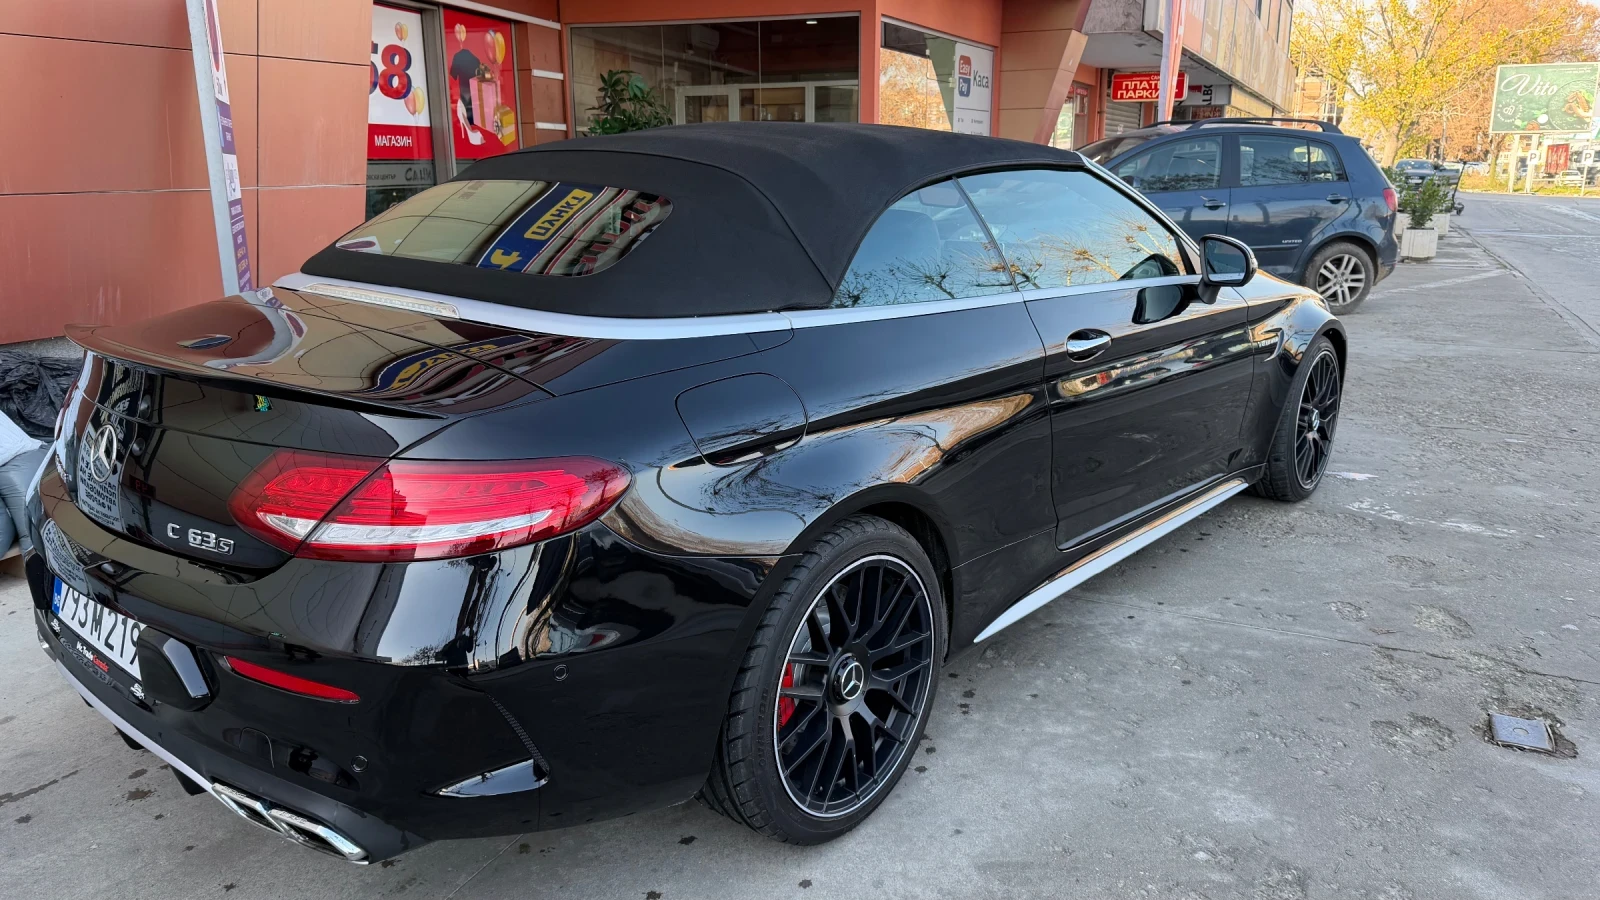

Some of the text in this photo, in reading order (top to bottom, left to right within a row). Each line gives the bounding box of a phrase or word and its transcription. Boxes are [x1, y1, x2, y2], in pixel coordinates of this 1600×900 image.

[959, 60, 971, 76] Easy
[959, 78, 968, 94] Pay
[1501, 73, 1558, 96] Vito
[374, 135, 412, 147] МАГАЗИН
[1530, 153, 1537, 161] P
[1584, 153, 1591, 161] P
[167, 523, 180, 539] C
